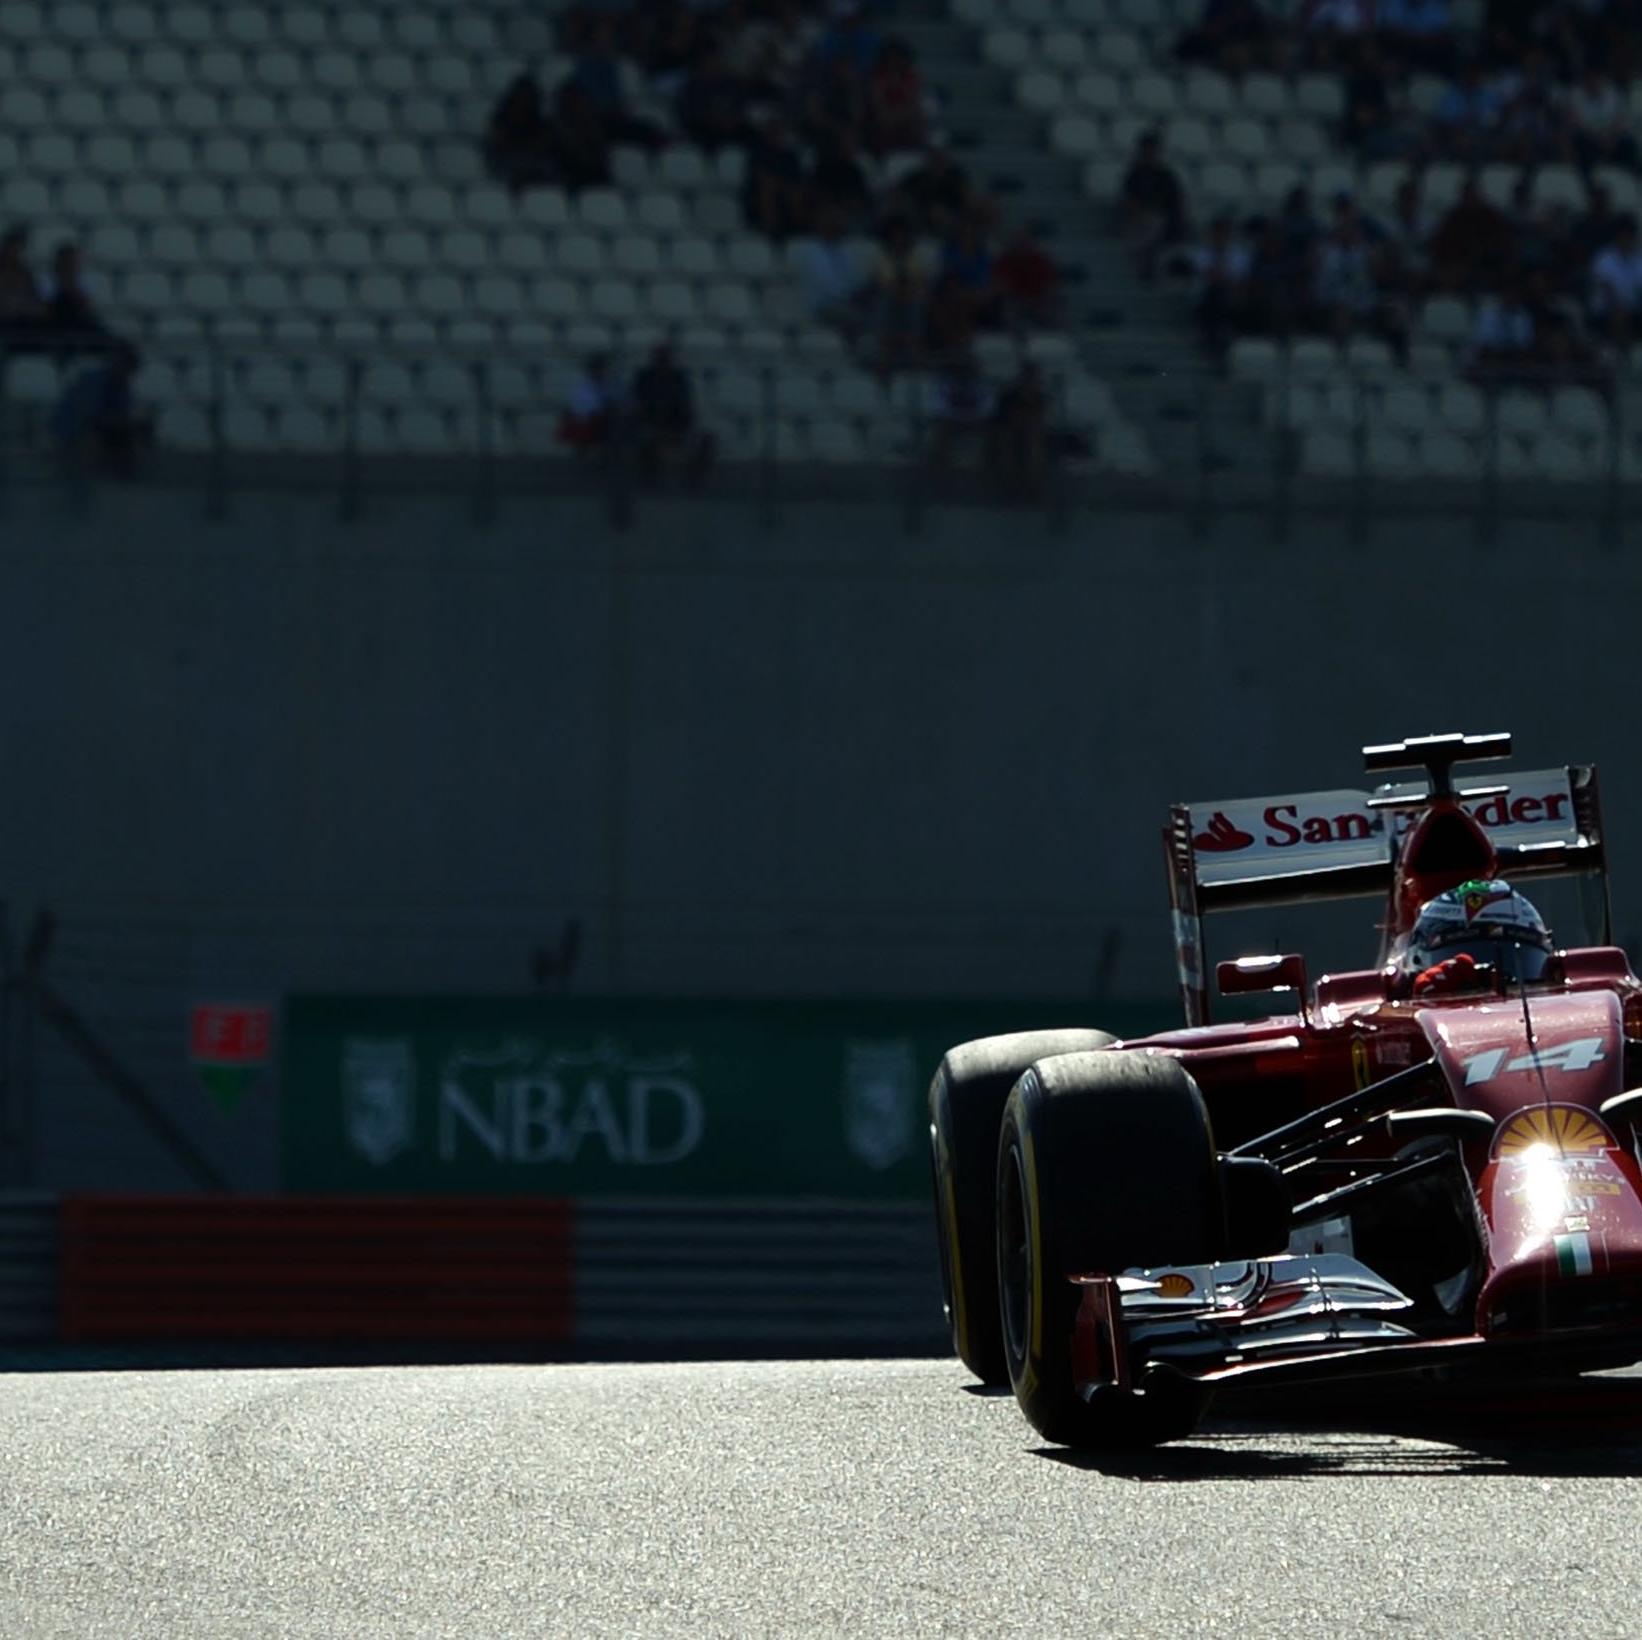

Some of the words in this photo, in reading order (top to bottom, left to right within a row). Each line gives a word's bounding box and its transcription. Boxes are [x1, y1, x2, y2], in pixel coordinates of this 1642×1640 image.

[1263, 794, 1569, 848] Sanader
[1461, 1037, 1605, 1087] 14
[437, 1075, 705, 1164] NBAD
